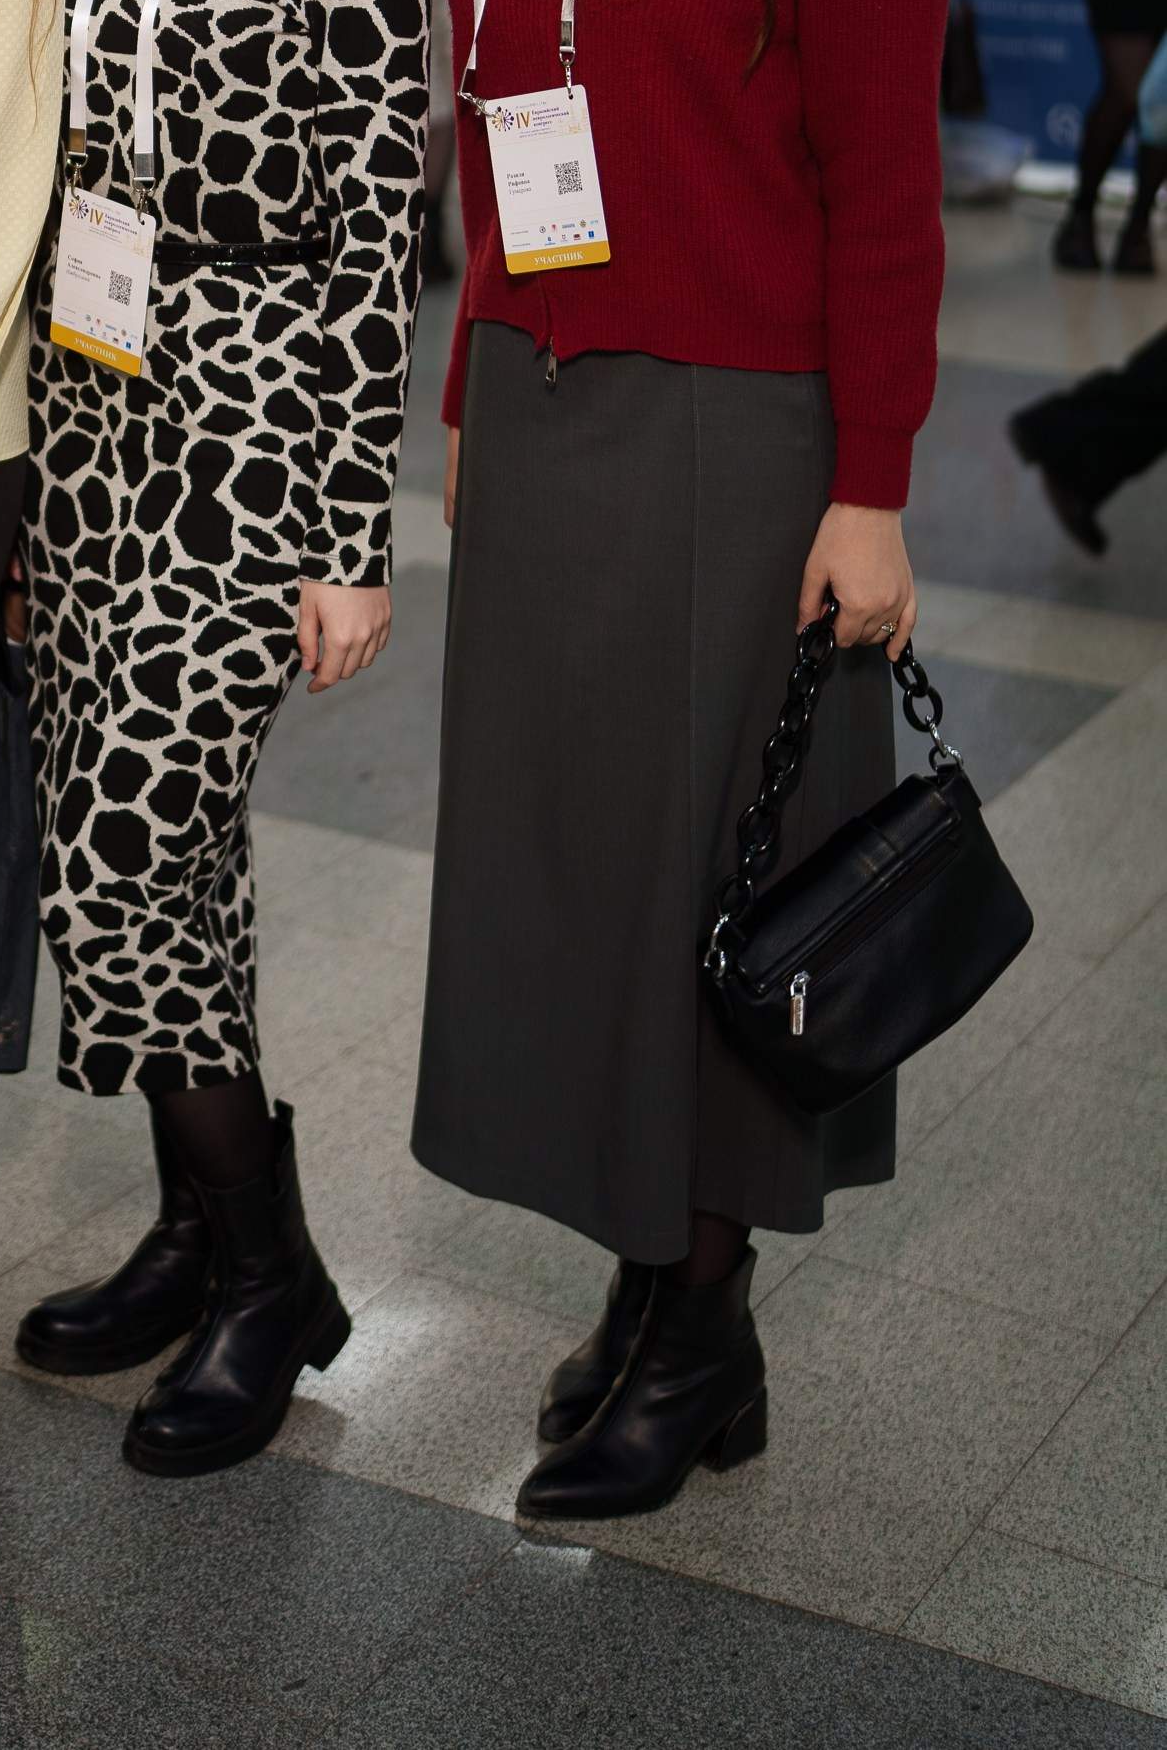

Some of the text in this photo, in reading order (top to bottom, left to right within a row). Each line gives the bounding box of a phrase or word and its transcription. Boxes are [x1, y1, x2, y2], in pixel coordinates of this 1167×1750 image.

[516, 111, 530, 129] IV
[89, 208, 104, 226] IV
[534, 251, 584, 266] УЧАСТНИК
[74, 337, 118, 362] УЧАСТНИК
